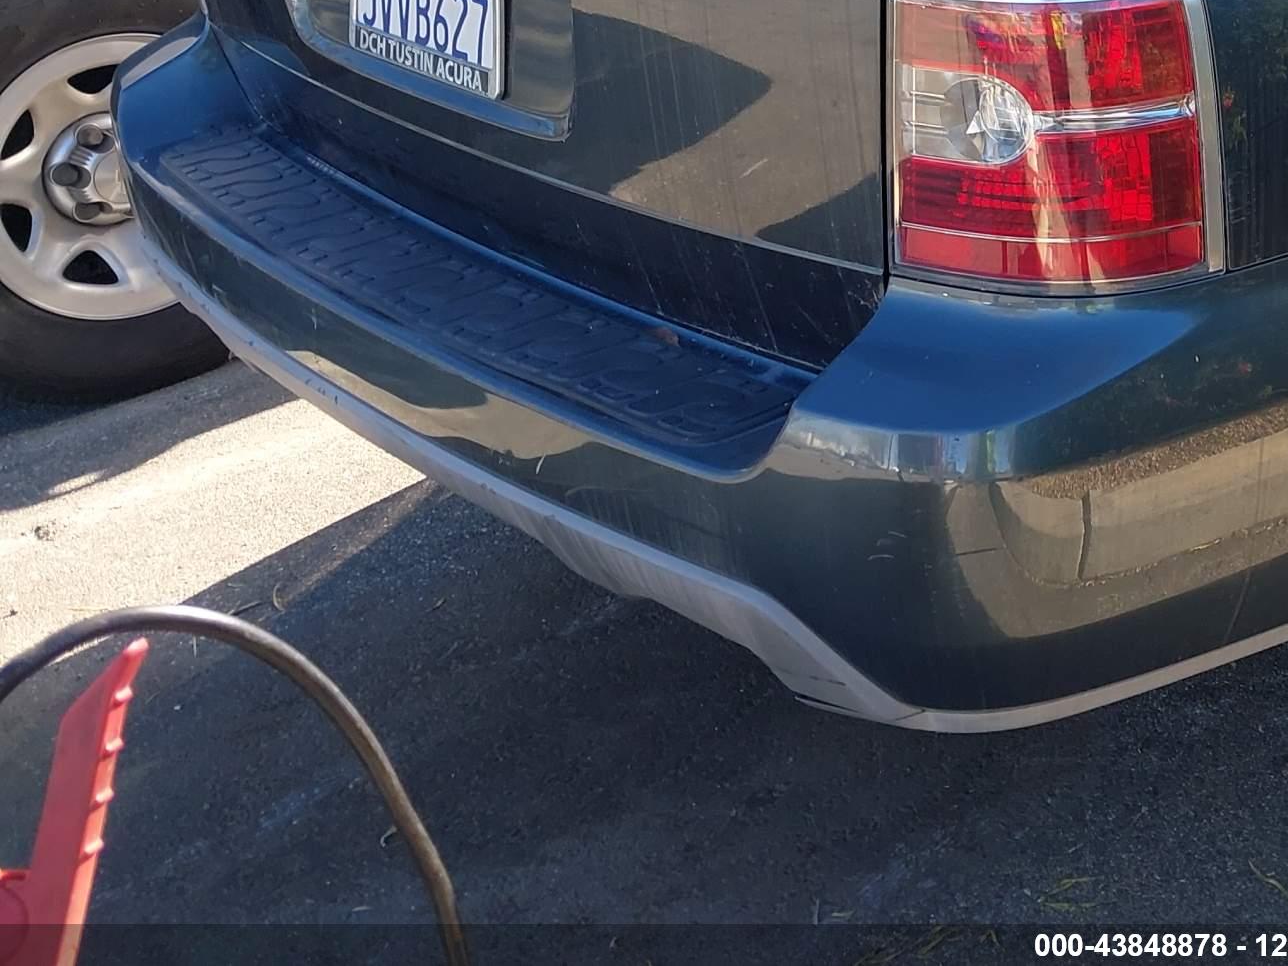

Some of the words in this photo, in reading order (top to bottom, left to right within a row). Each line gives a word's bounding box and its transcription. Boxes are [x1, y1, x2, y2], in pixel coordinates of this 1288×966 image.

[359, 29, 386, 57] DCH
[386, 37, 434, 75] TUSTIN
[435, 57, 482, 91] ACURA
